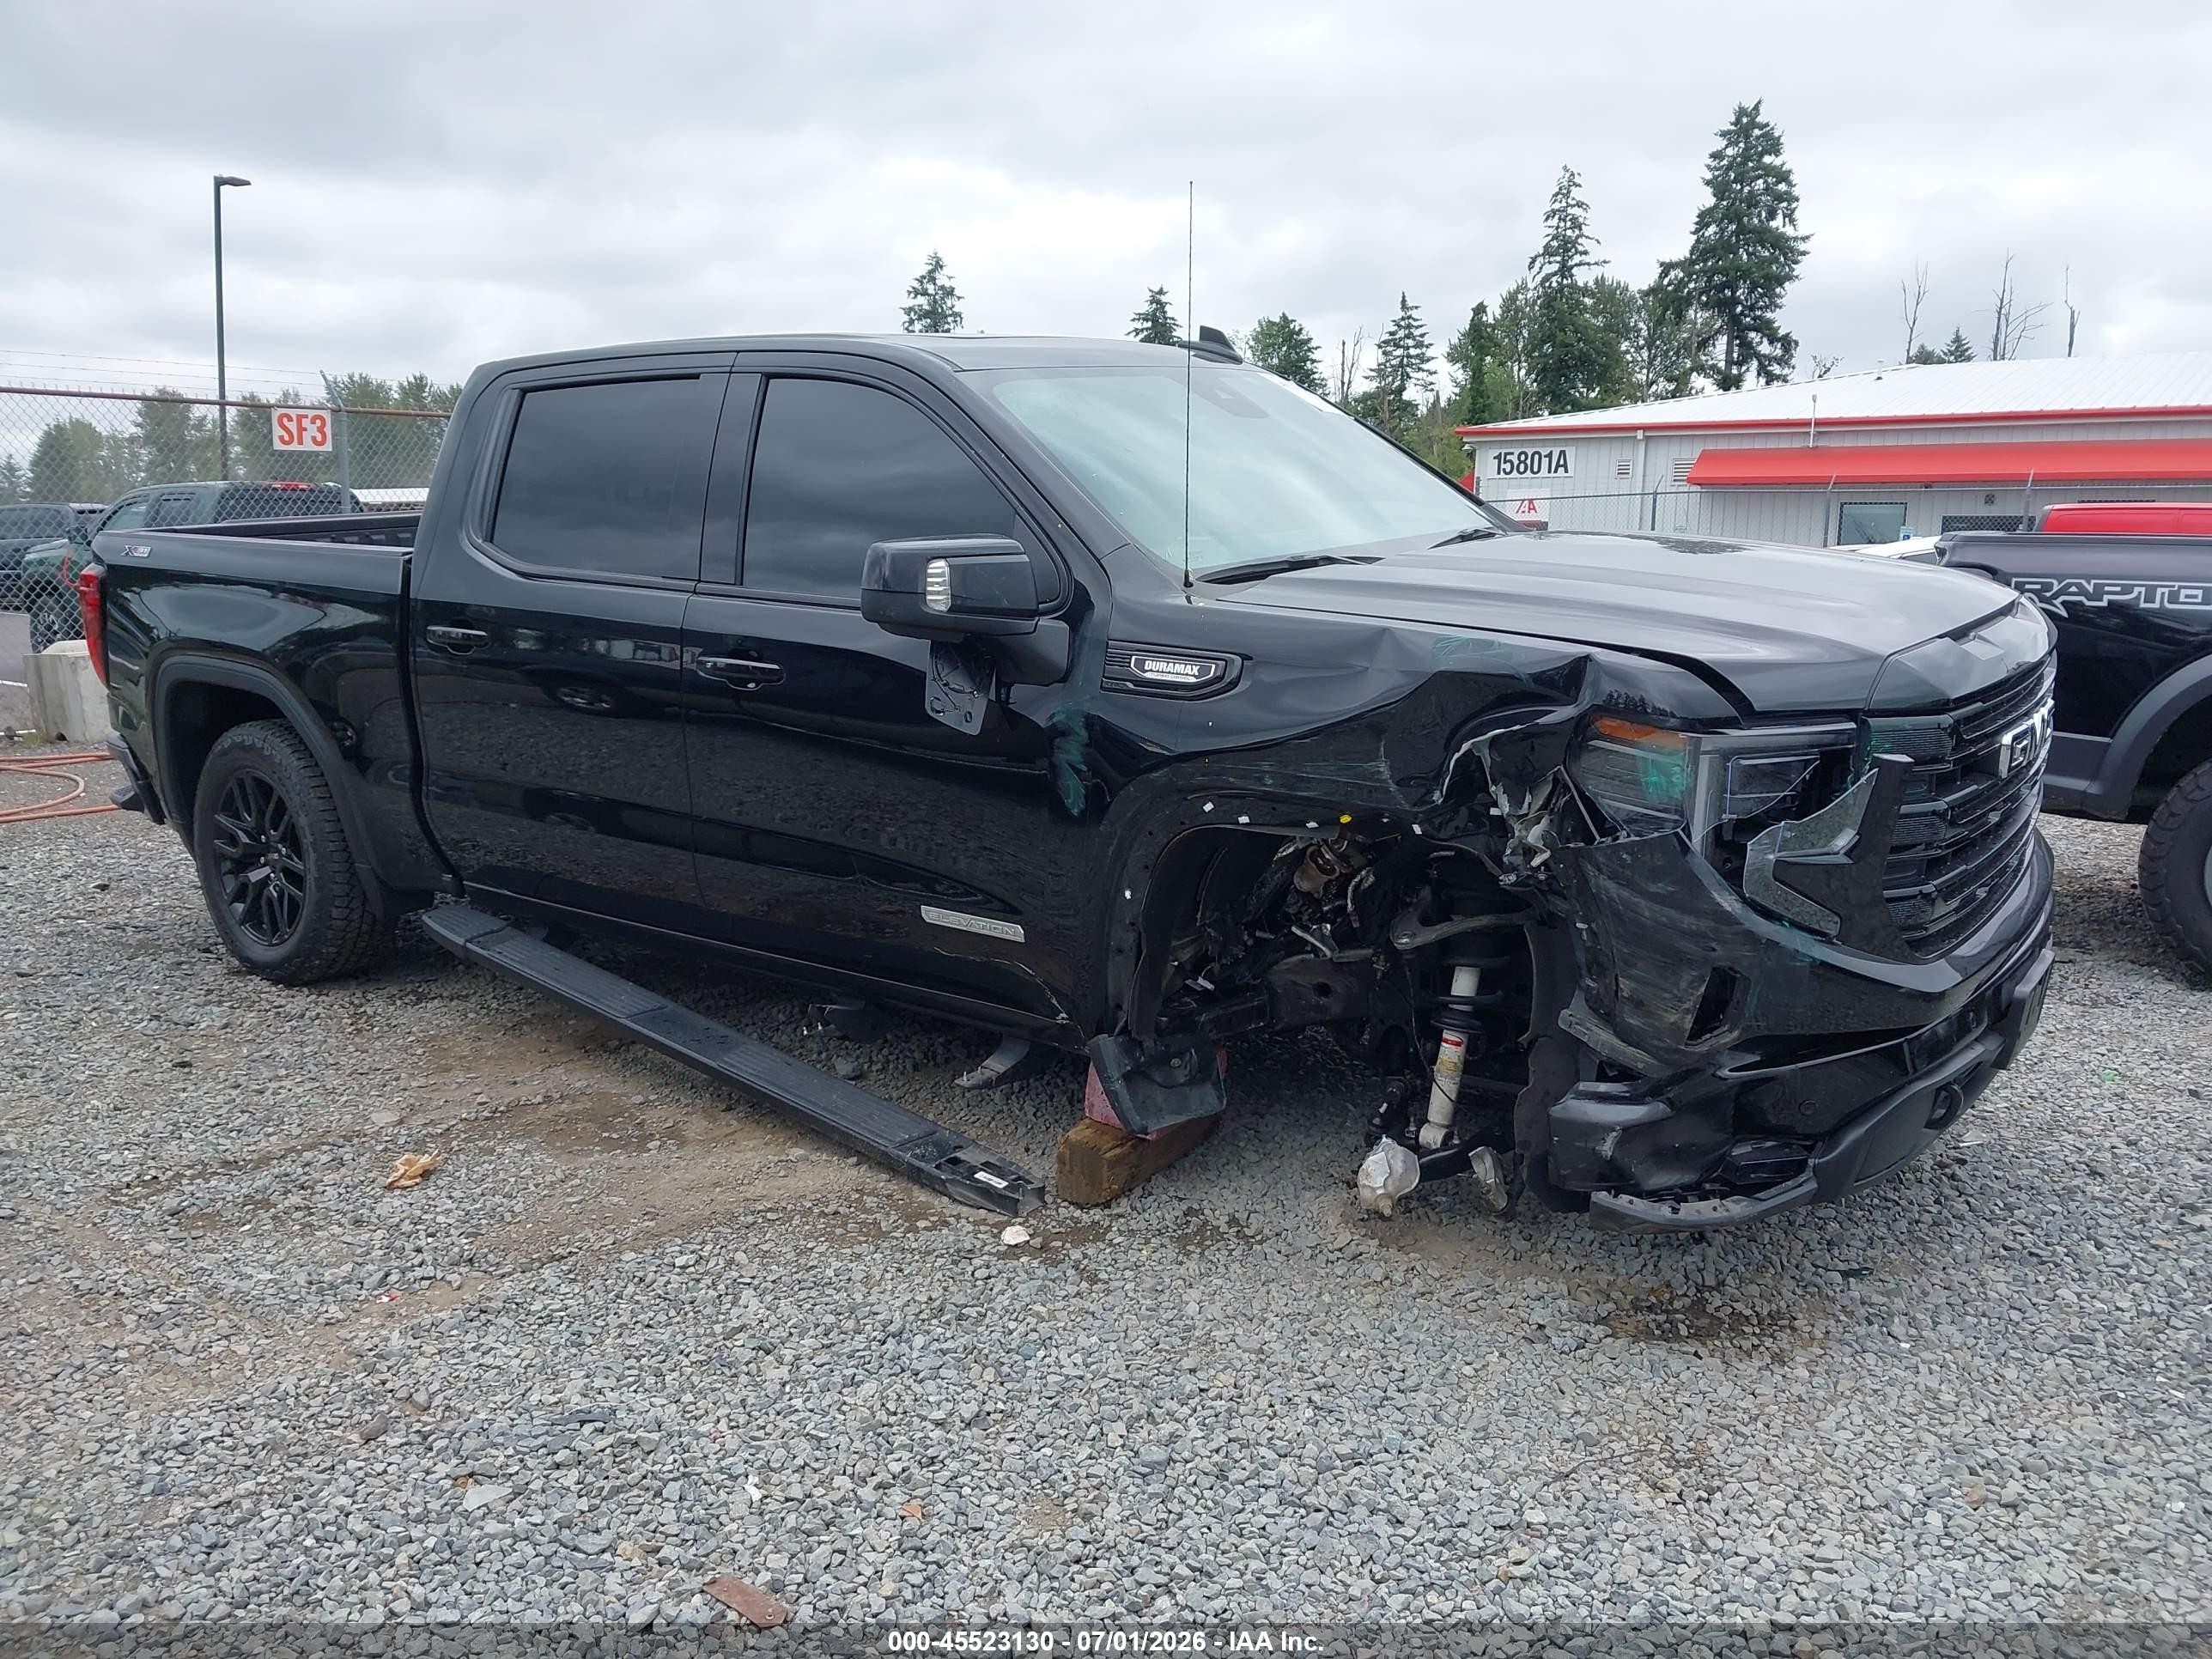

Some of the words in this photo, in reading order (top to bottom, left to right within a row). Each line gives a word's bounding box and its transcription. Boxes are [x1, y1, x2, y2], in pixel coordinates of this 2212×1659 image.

[277, 412, 327, 447] SF3
[1492, 449, 1570, 476] 15801A
[1144, 659, 1200, 676] DURAMAX
[928, 911, 1017, 937] ELEVATION
